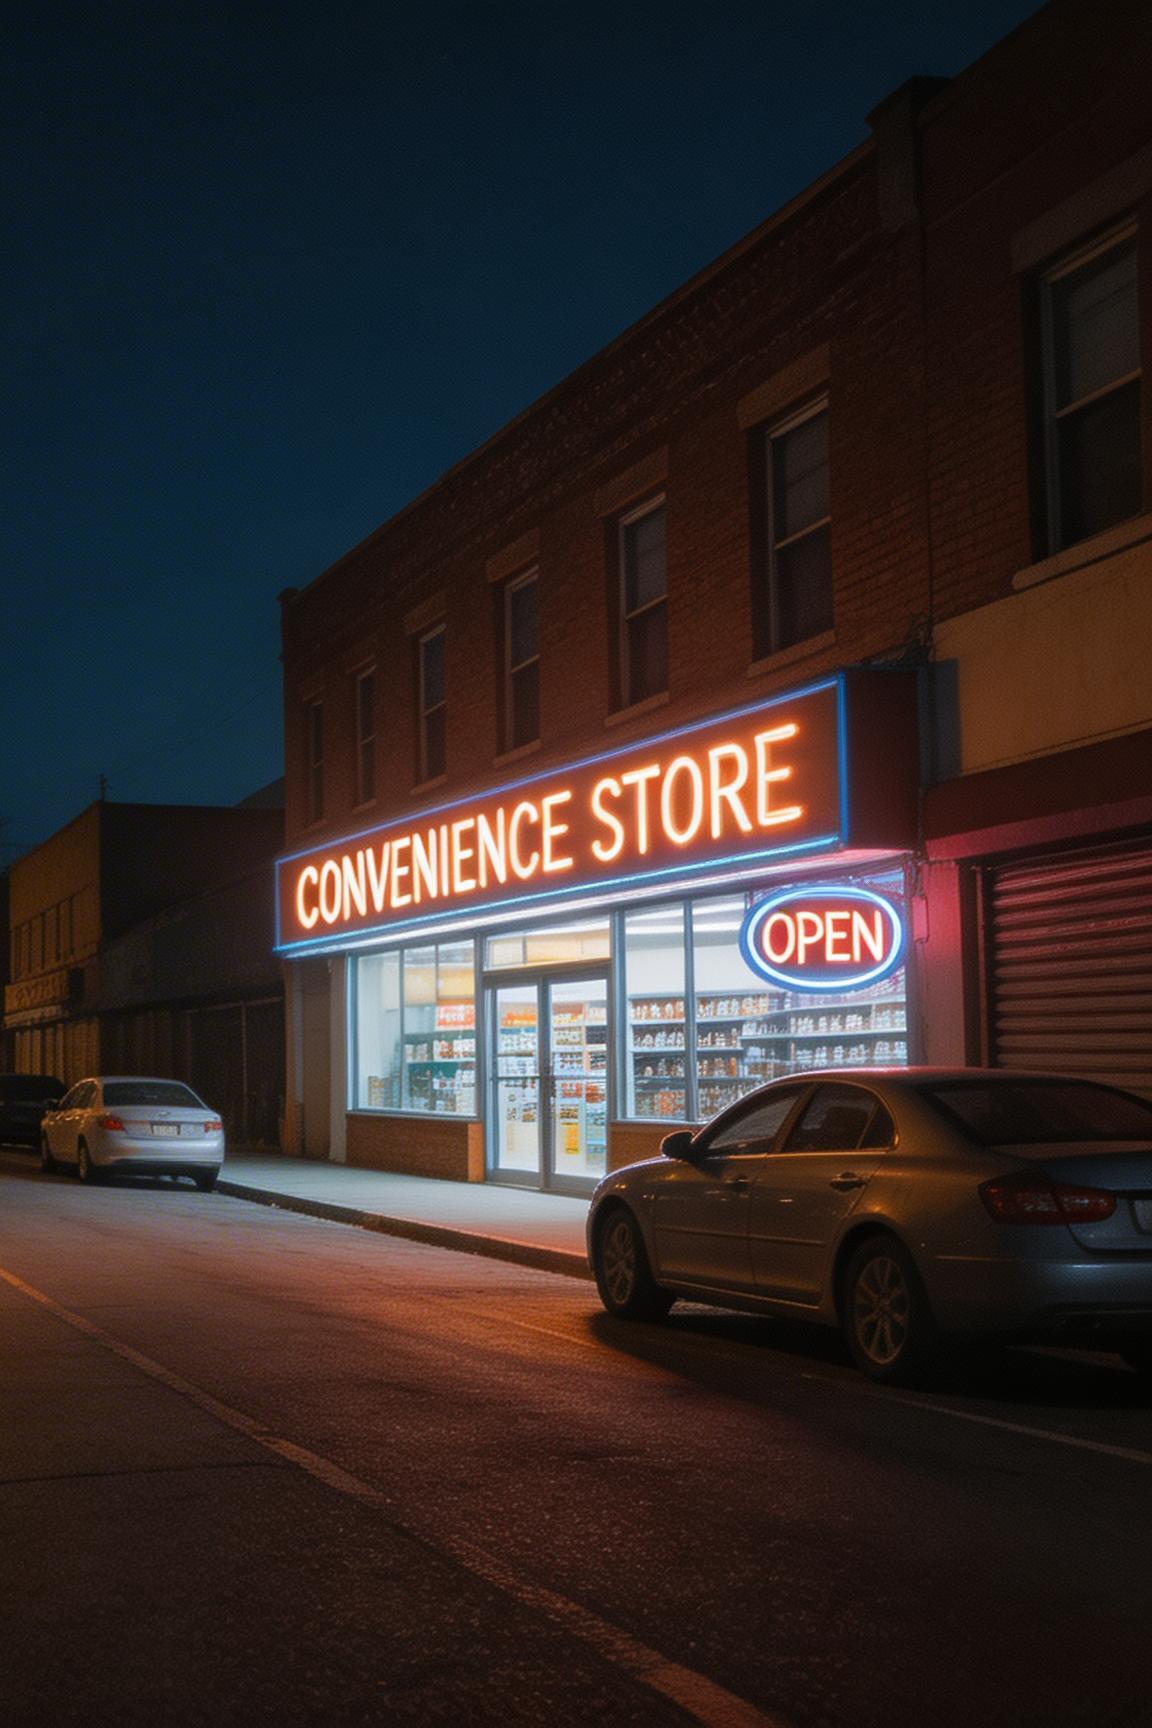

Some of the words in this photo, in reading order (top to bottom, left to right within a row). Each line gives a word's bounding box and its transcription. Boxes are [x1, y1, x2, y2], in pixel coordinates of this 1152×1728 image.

[296, 790, 573, 930] CONVENIENCE
[590, 723, 802, 862] STORE
[762, 910, 885, 964] OPEN
